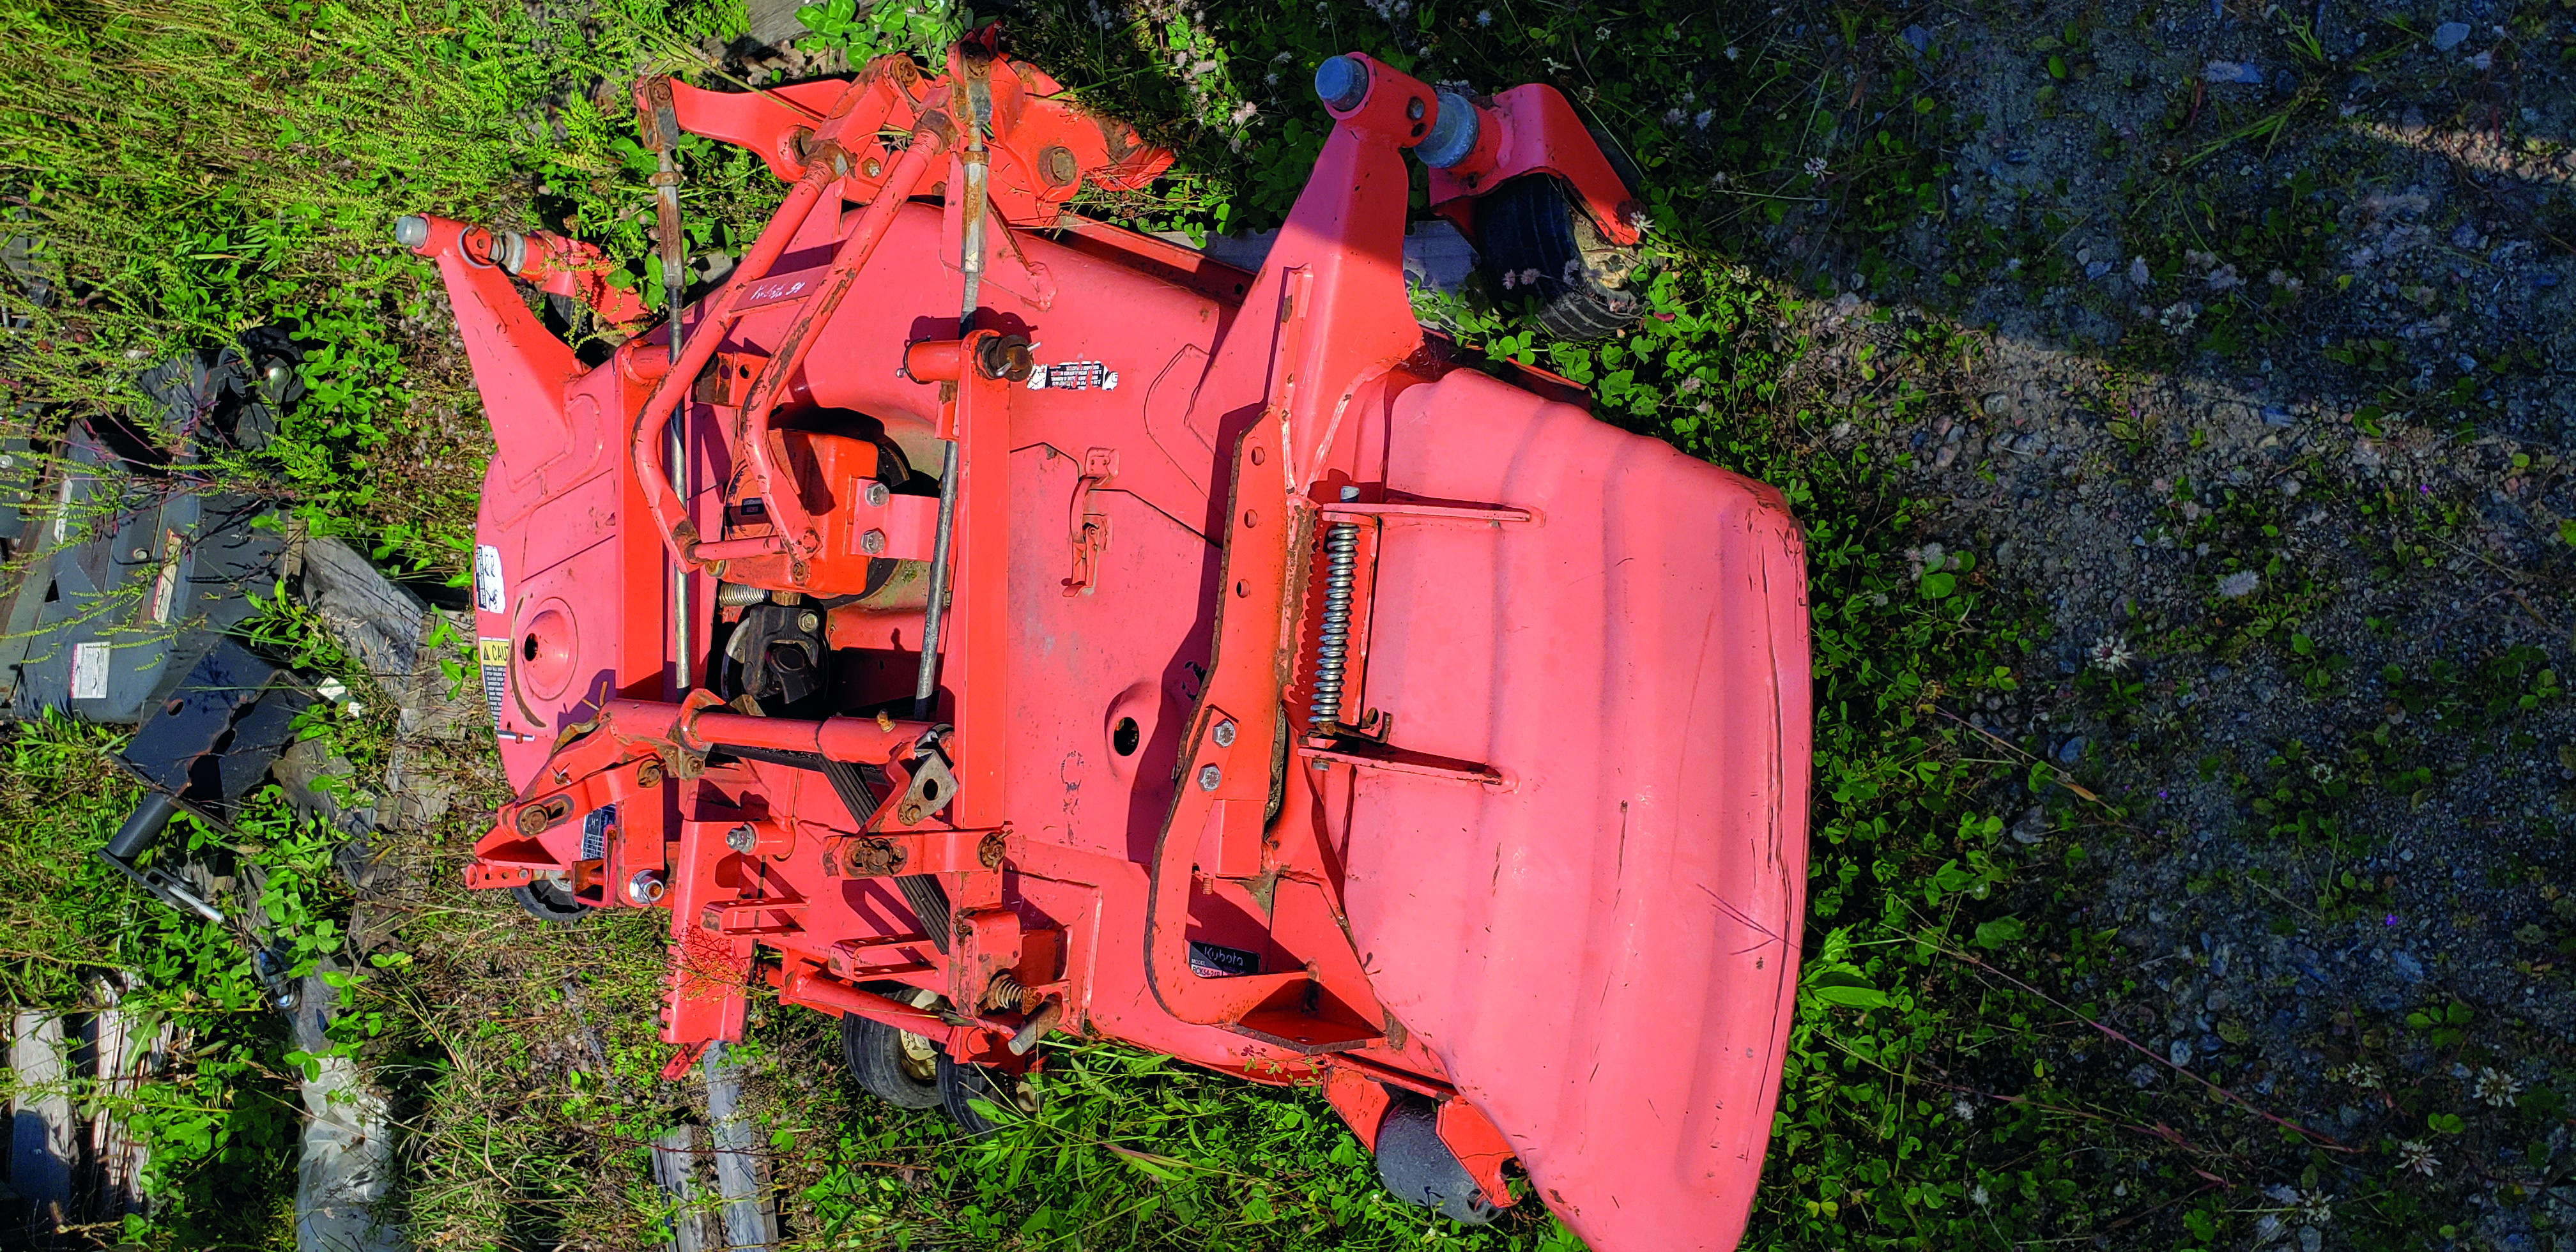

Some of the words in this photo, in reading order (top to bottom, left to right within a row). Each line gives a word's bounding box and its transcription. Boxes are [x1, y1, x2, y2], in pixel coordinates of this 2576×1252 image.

[492, 645, 509, 661] CAU
[1191, 958, 1206, 966] MODEL
[1204, 946, 1243, 966] Kubota
